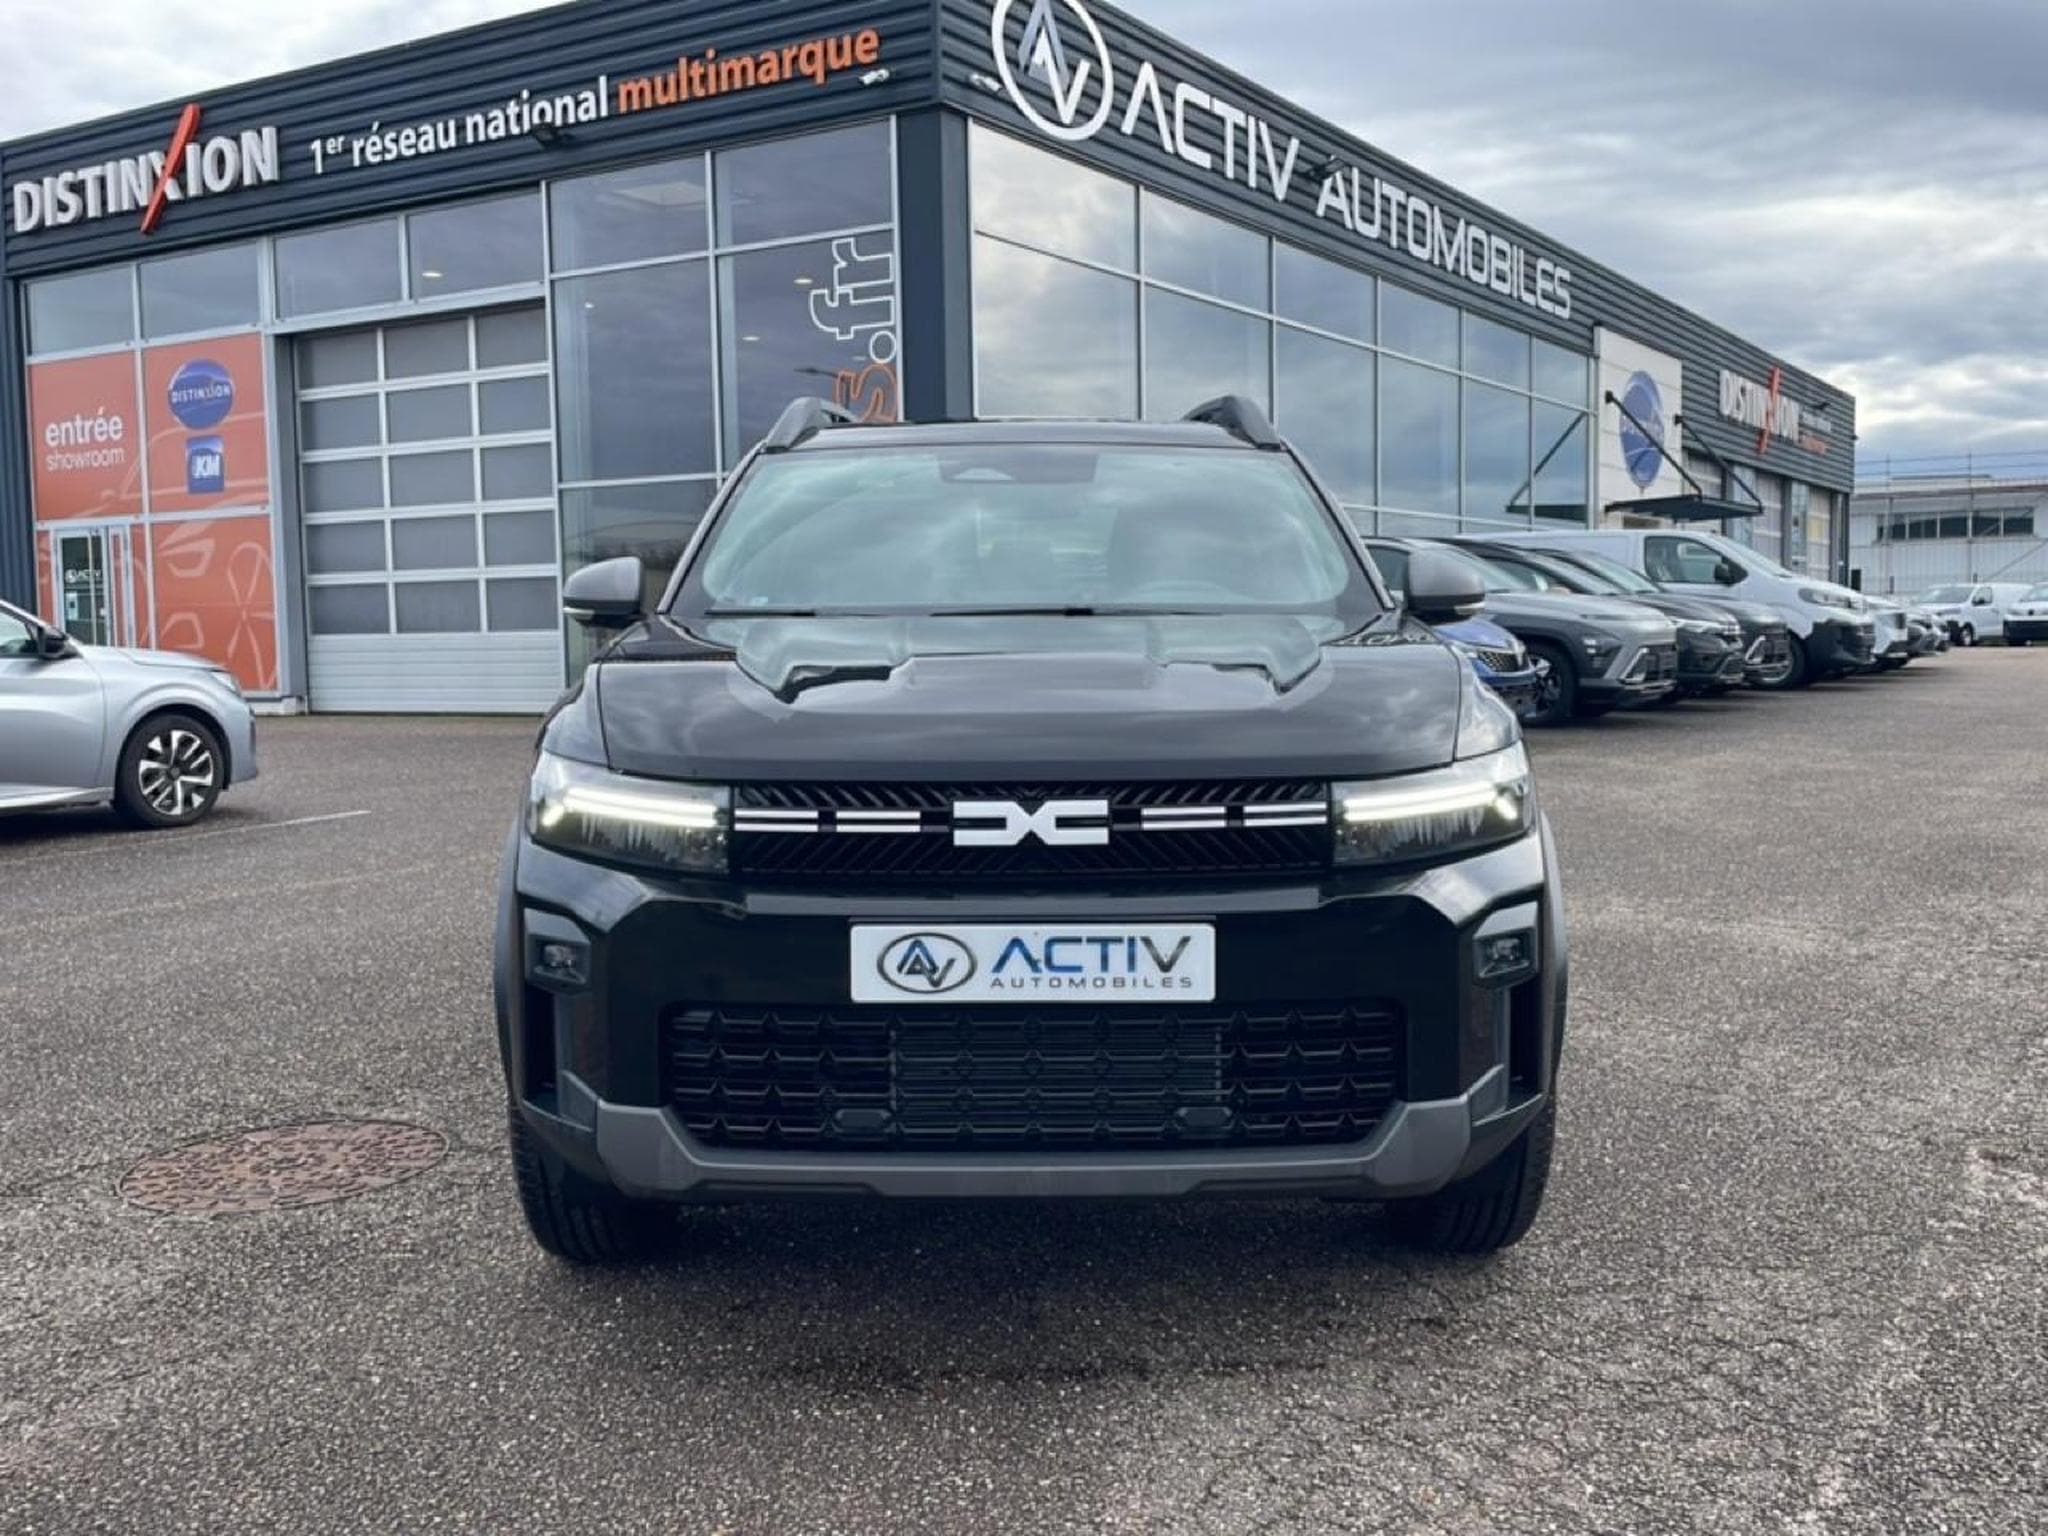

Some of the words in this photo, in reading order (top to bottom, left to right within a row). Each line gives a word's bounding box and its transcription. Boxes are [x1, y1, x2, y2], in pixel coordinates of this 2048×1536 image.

[352, 121, 457, 167] réseau
[465, 74, 609, 144] national
[618, 28, 880, 114] multimarque
[1121, 61, 1299, 201] ACTIV
[1316, 166, 1571, 319] AUTOMOBILES
[45, 406, 123, 447] entrée
[45, 446, 125, 472] showroom
[991, 935, 1192, 974] ACTIV
[990, 976, 1193, 989] AUTOMOBILES
